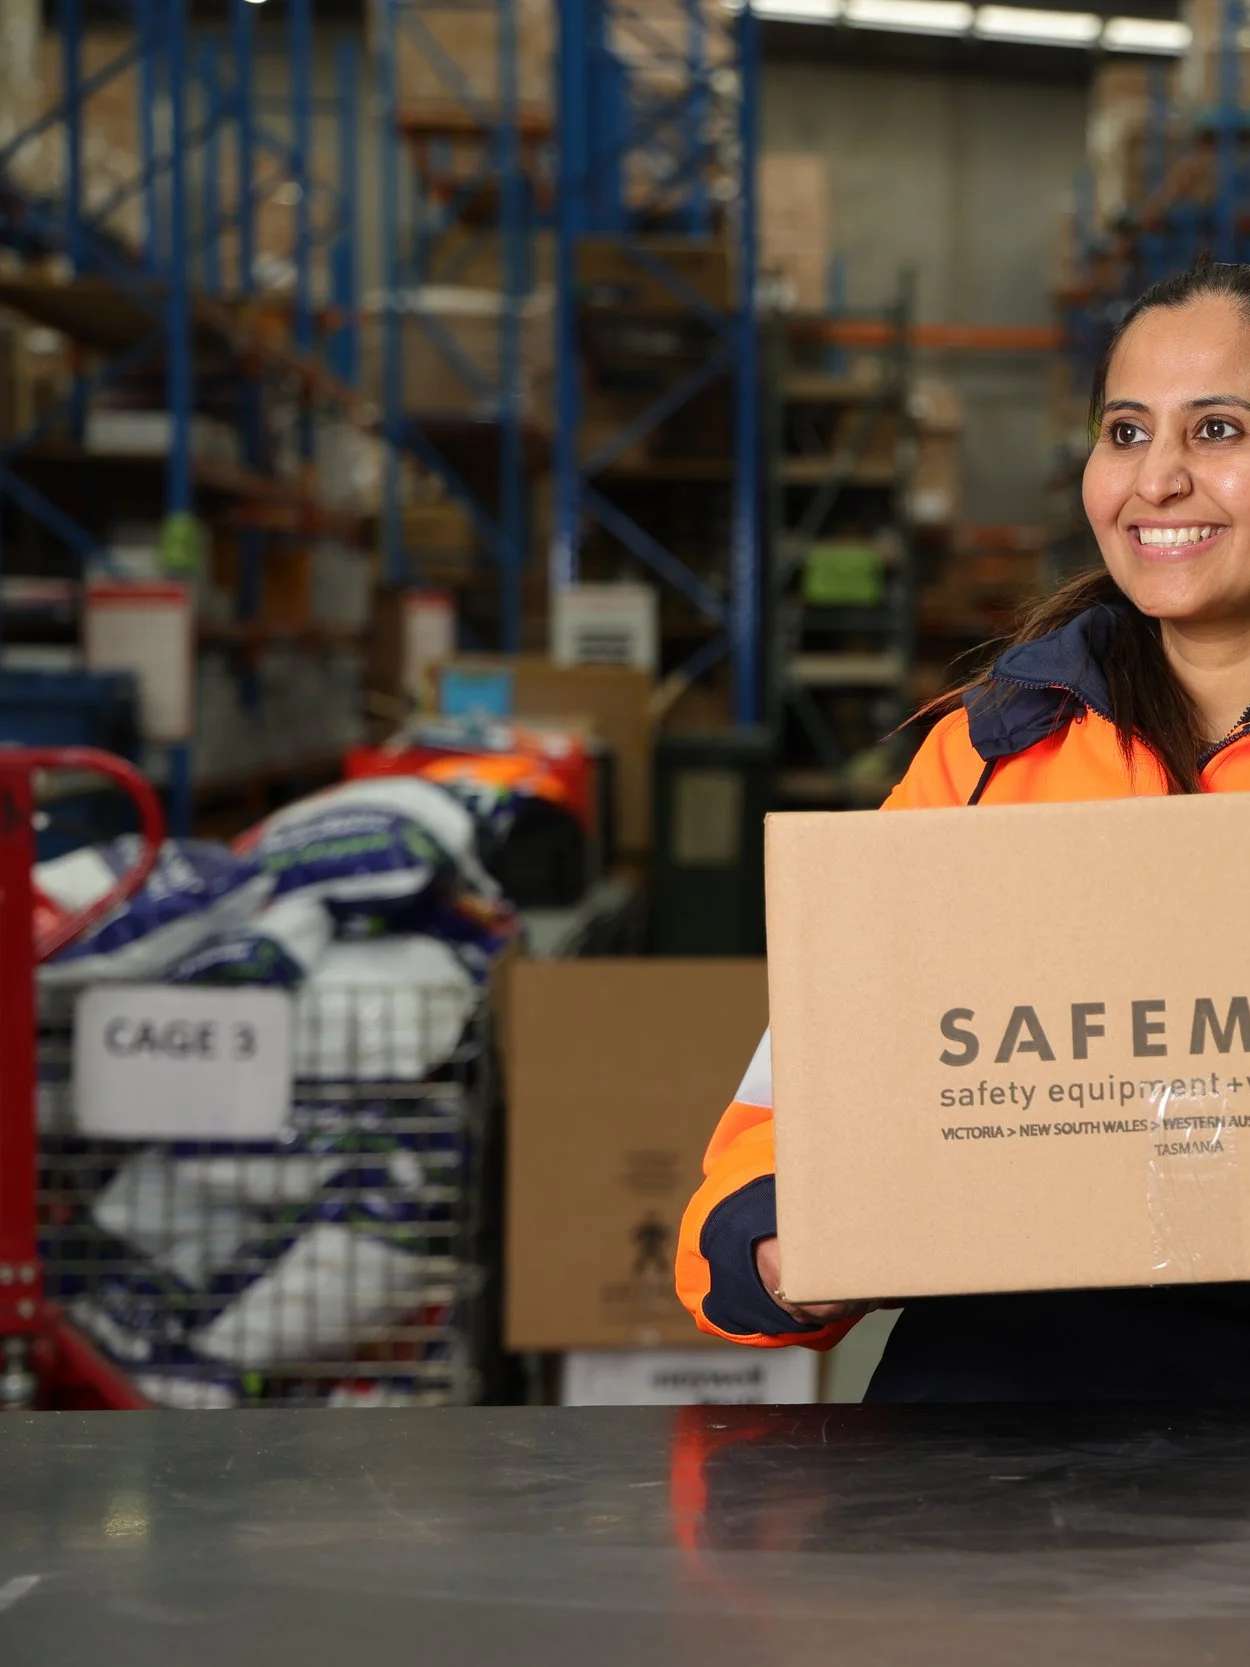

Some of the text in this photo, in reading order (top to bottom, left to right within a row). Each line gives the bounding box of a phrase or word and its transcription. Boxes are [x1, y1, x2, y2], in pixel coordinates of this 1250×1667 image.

[103, 1016, 258, 1063] CAGE 3
[940, 1080, 1036, 1110] safety
[941, 1126, 1004, 1140] VICTORIA
[1019, 1123, 1052, 1137] NEW
[1054, 1121, 1100, 1136] SOUTH
[1102, 1118, 1148, 1133] WALES
[1162, 1115, 1226, 1131] WESTERN
[1153, 1139, 1225, 1157] TASMANIA
